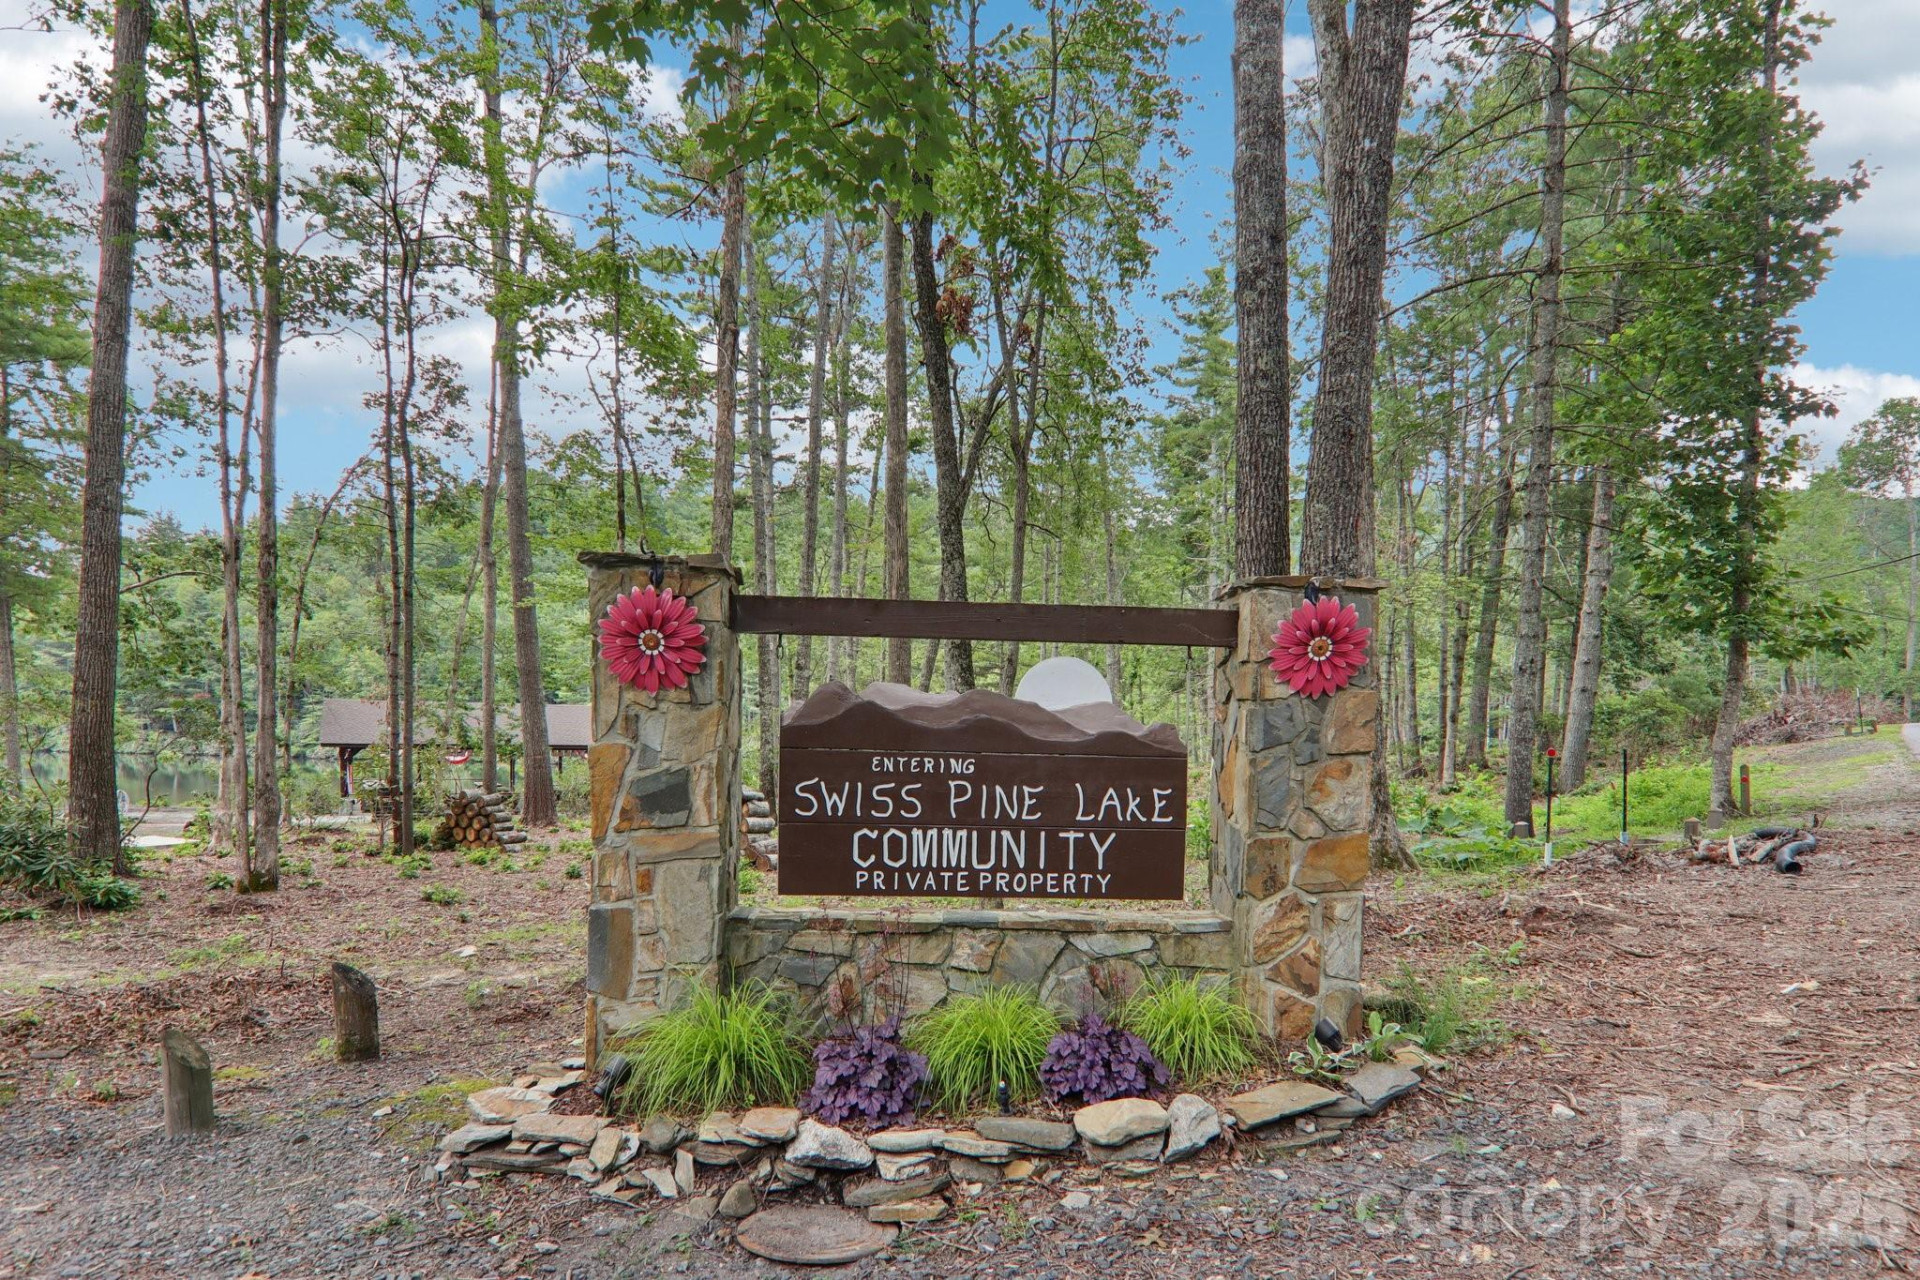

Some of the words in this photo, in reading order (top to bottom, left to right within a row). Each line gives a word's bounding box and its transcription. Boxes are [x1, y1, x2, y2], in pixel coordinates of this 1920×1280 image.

[871, 755, 976, 774] ENTERING
[794, 777, 923, 818] SWISS
[948, 780, 1045, 820] PINE
[852, 827, 1117, 871] COMMUNITY
[855, 870, 970, 892] PRIVATE
[979, 871, 1112, 894] PROPERTY
